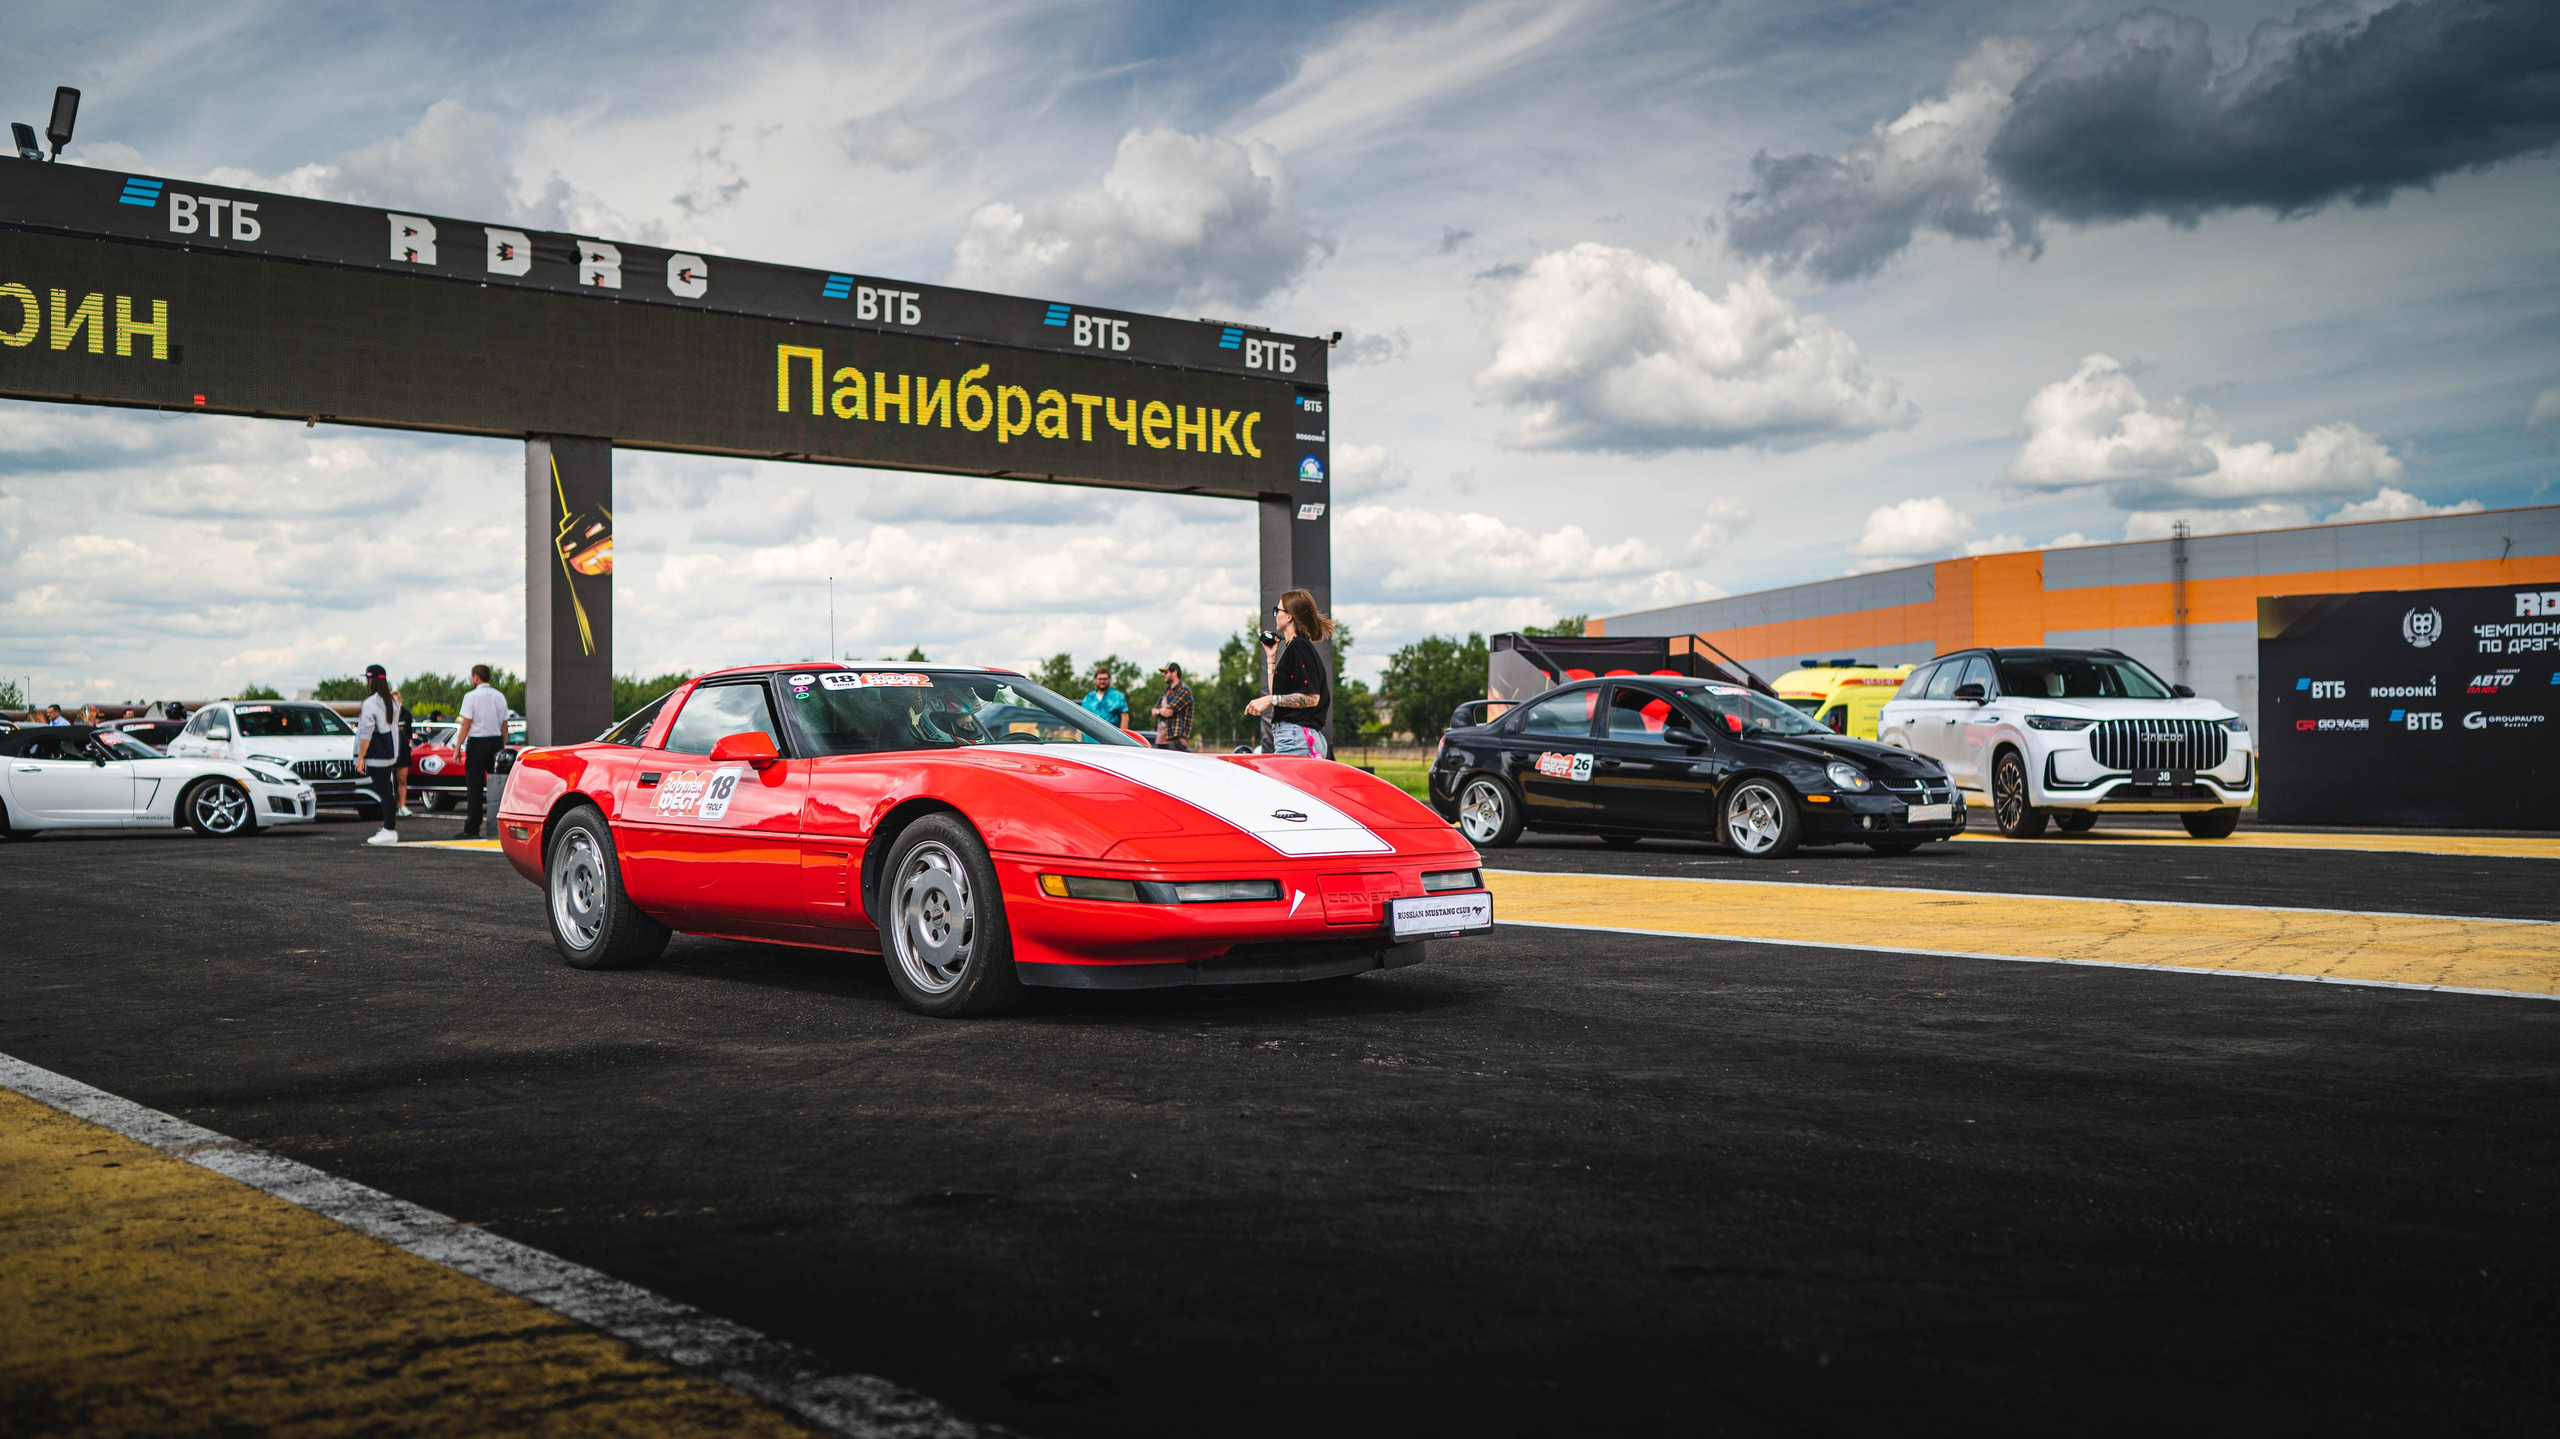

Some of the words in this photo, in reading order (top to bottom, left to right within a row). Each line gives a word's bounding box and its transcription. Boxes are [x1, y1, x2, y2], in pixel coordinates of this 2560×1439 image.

[170, 192, 262, 242] ВТБ
[857, 286, 921, 326] ВТБ
[1074, 315, 1130, 352] ВТБ
[1246, 338, 1297, 373] ВТБ
[1304, 400, 1322, 412] ВТБ
[2474, 622, 2560, 637] ЧЕМПИОН
[2479, 639, 2502, 653] ПО
[2508, 637, 2560, 654] ДРЭГ-
[825, 675, 856, 684] 18
[2470, 674, 2514, 687] АВТО
[2312, 681, 2346, 699] ВТБ
[2407, 712, 2444, 730] ВТБ
[2488, 715, 2545, 723] GROUPAUTO
[1574, 758, 1590, 771] 26
[710, 776, 736, 799] 18
[659, 793, 699, 811] ФЕСТ
[1398, 910, 1424, 920] RUSSIAN
[1425, 907, 1456, 918] MUSTANG
[1456, 906, 1471, 915] CLUB
